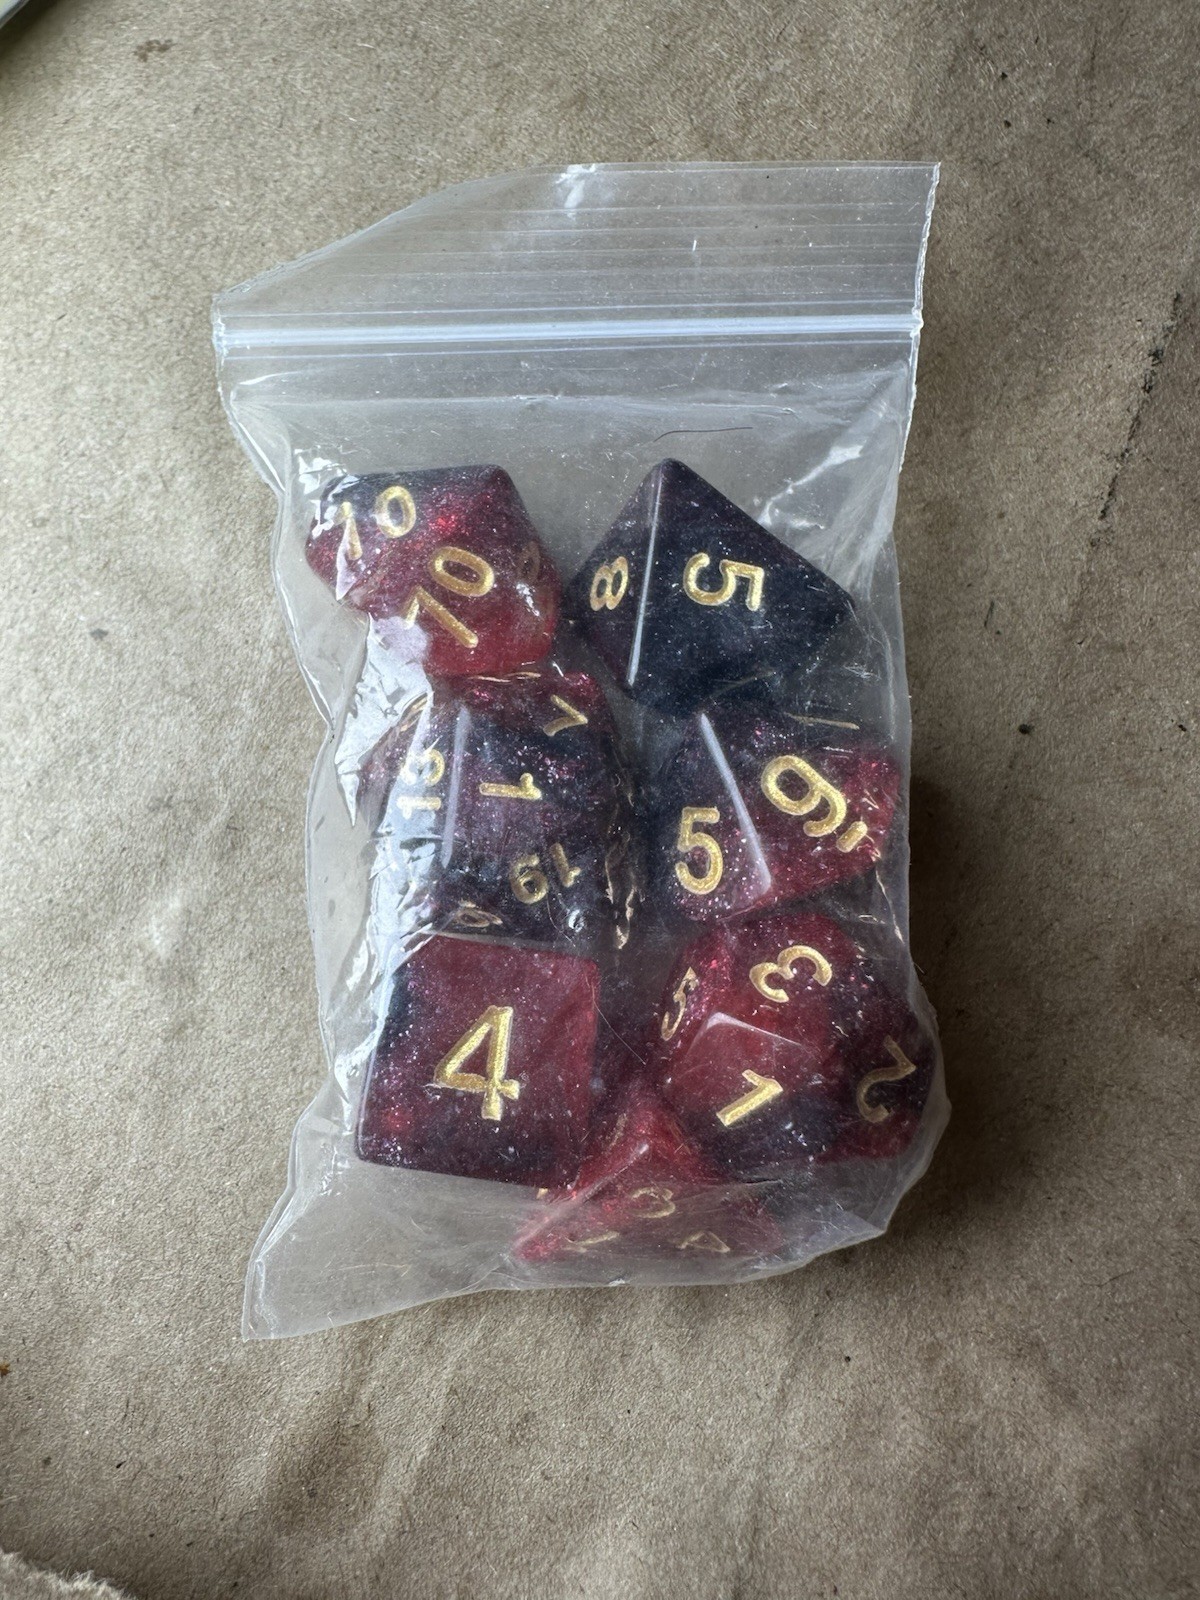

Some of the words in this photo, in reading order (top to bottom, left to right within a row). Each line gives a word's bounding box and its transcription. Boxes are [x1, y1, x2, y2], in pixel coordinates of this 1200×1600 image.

[402, 545, 496, 649] 70
[589, 556, 628, 611] 8
[682, 552, 766, 611] 5
[543, 694, 589, 737] 7
[479, 772, 543, 800] 1
[510, 842, 583, 904] 19
[675, 806, 724, 895] 5
[749, 944, 833, 1003] 3
[433, 1004, 521, 1122] 4
[856, 1034, 917, 1123] 2
[715, 1069, 784, 1128] 1
